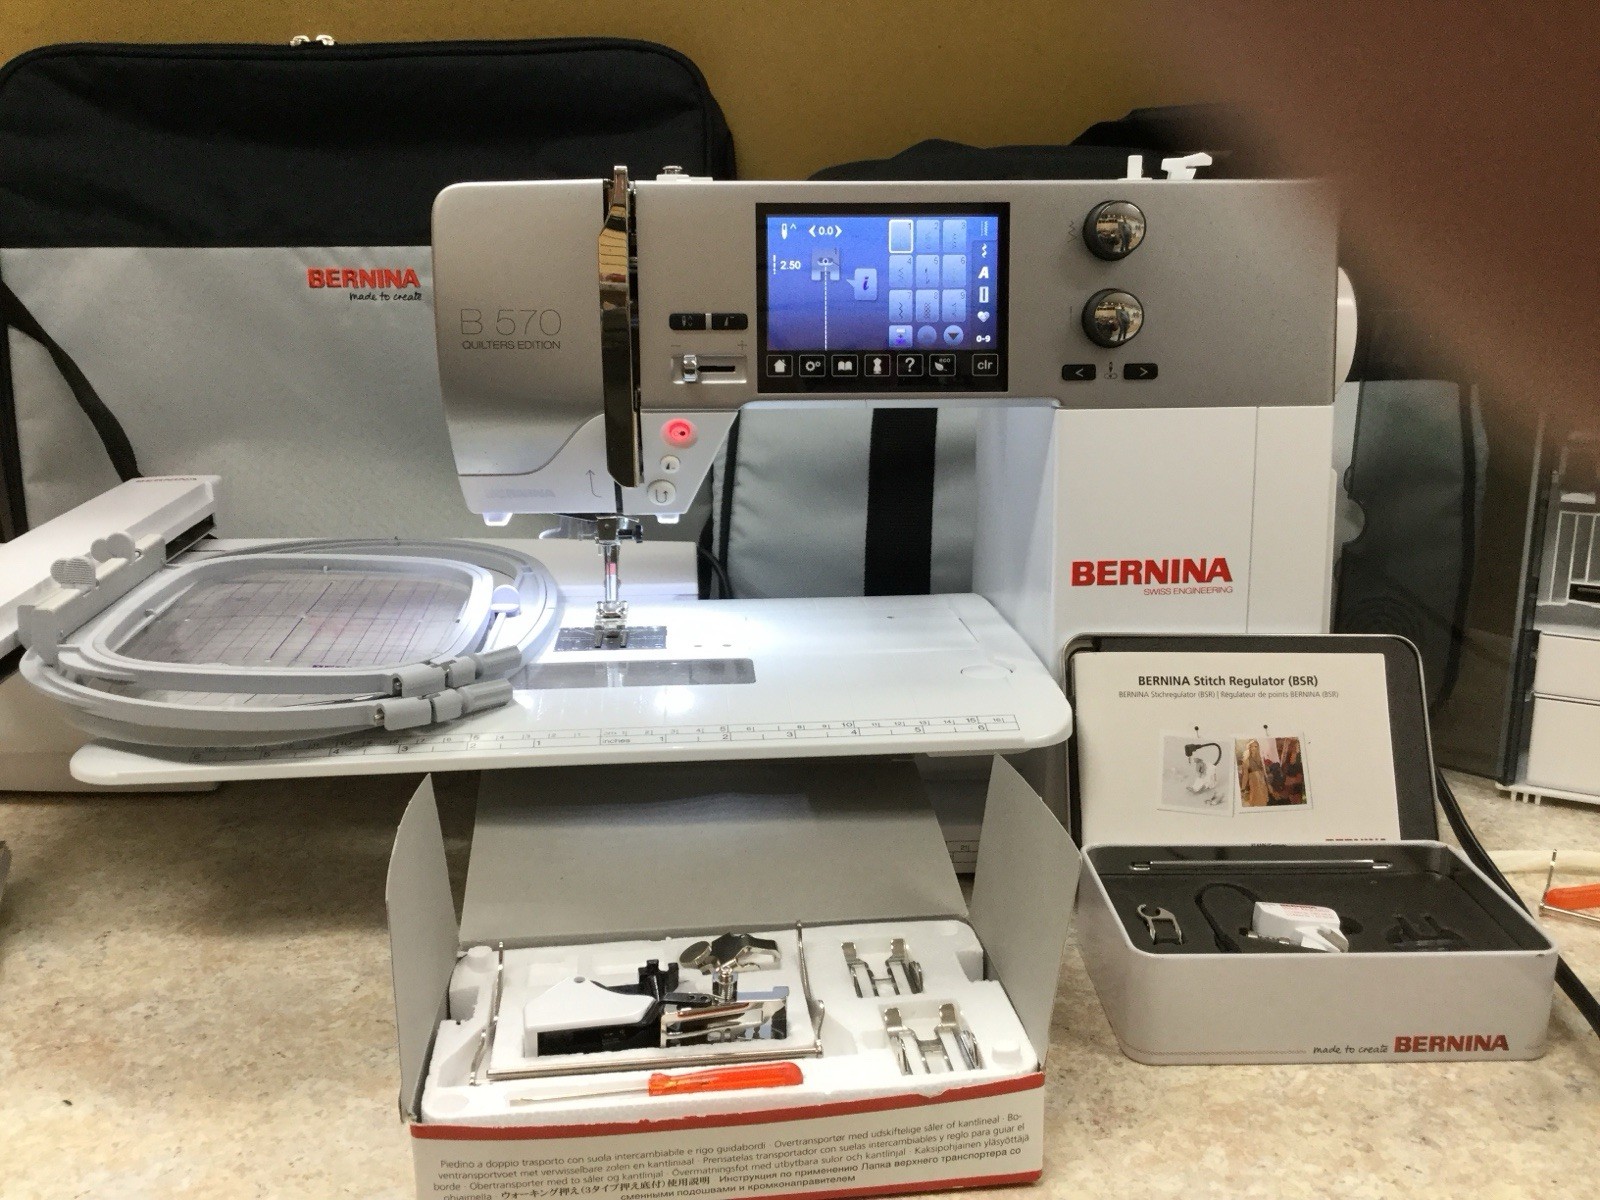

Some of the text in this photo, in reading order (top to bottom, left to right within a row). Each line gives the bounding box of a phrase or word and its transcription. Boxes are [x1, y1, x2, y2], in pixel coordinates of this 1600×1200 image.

[818, 226, 834, 236] 0.0
[780, 260, 801, 270] 2.50
[306, 267, 421, 289] BERNINA
[978, 266, 990, 279] A
[350, 291, 422, 301] made to create
[460, 308, 562, 336] B 570
[462, 340, 561, 350] QUILTERS EDITION
[976, 335, 991, 343] 0-9
[977, 360, 993, 370] clr
[1071, 557, 1233, 587] BERNINA
[1143, 586, 1233, 596] SWISS ENGINEERING
[1138, 675, 1318, 688] BERNINA Stitch Regulator (BSR)
[1151, 690, 1196, 699] Stichregulator
[1198, 691, 1216, 699] (BSR)
[1258, 690, 1266, 698] de
[1268, 691, 1288, 699] points
[1322, 690, 1339, 698] (BSR)
[1313, 1034, 1509, 1054] made to create BERNINA
[440, 1160, 475, 1168] Piedino
[486, 1160, 519, 1169] doppio
[522, 1157, 564, 1167] trasporto
[567, 1157, 584, 1165] con
[587, 1154, 612, 1162] suola
[614, 1148, 685, 1160] intercambiabile
[695, 1147, 714, 1156] rigo
[716, 1142, 766, 1154] guidabordi
[848, 1131, 868, 1140] med
[871, 1125, 922, 1138] udskiftelige
[924, 1123, 943, 1132] såler
[946, 1120, 955, 1129] of
[958, 1115, 1000, 1127] kantlineal
[1007, 1113, 1022, 1122] Bo-
[438, 1170, 518, 1180] ventransportvoet
[520, 1169, 538, 1177] met
[540, 1166, 603, 1176] verwisselbare
[606, 1164, 630, 1172] zolen
[702, 1154, 753, 1164] Prensatelas
[756, 1147, 818, 1160] transportador
[820, 1145, 836, 1154] con
[839, 1142, 866, 1151] suelas
[868, 1134, 937, 1148] intercambiables
[971, 1128, 991, 1139] para
[992, 1125, 1015, 1136] guiar
[1017, 1123, 1025, 1131] el
[433, 1182, 461, 1191] borde
[469, 1180, 544, 1190] Obertransporter
[547, 1177, 568, 1186] med
[583, 1175, 604, 1183] såler
[607, 1174, 620, 1182] og
[751, 1161, 772, 1170] med
[775, 1158, 818, 1169] utbytbara
[821, 1155, 843, 1164] sulor
[845, 1153, 863, 1161] och
[865, 1149, 906, 1160] kantlinjal
[914, 1140, 981, 1154] Kaksipohjainen
[719, 1147, 1021, 1183] Инструкция по применению Лапка верхнего транспортера со
[676, 1186, 736, 1196] подошвами
[747, 1175, 856, 1192] кромконаправителем
